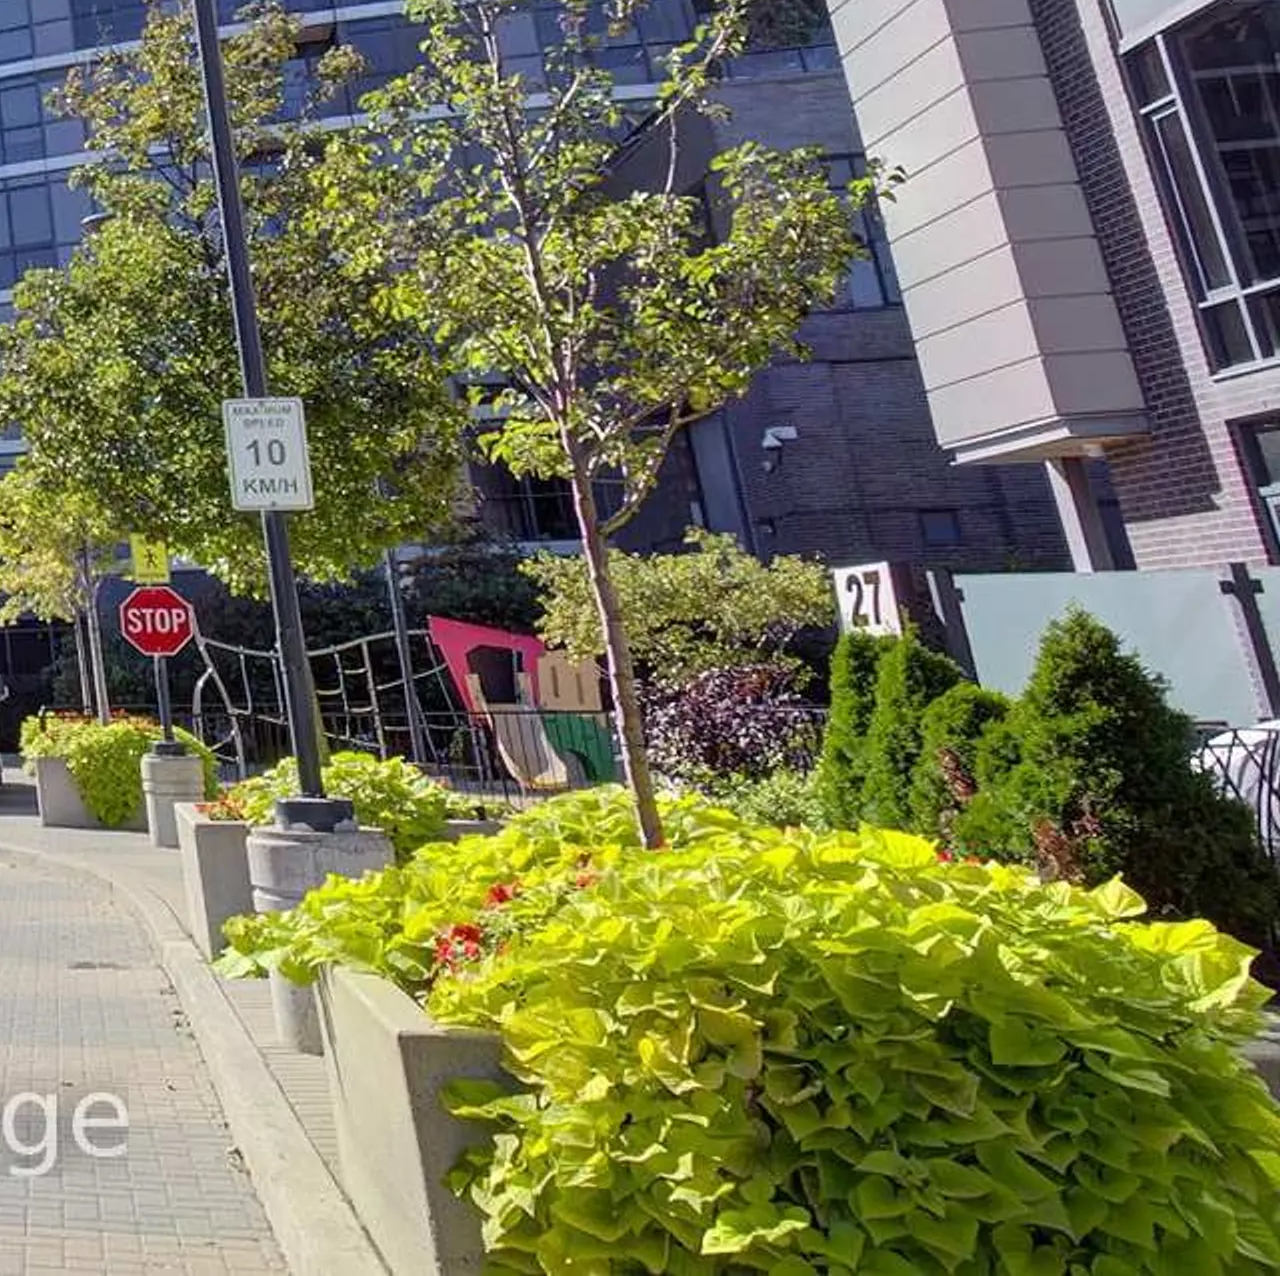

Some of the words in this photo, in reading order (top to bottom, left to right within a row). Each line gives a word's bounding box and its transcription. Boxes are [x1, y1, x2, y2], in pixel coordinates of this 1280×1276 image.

[246, 438, 287, 466] 10
[242, 478, 298, 495] KM/H
[846, 570, 882, 628] 27
[127, 608, 187, 634] STOP
